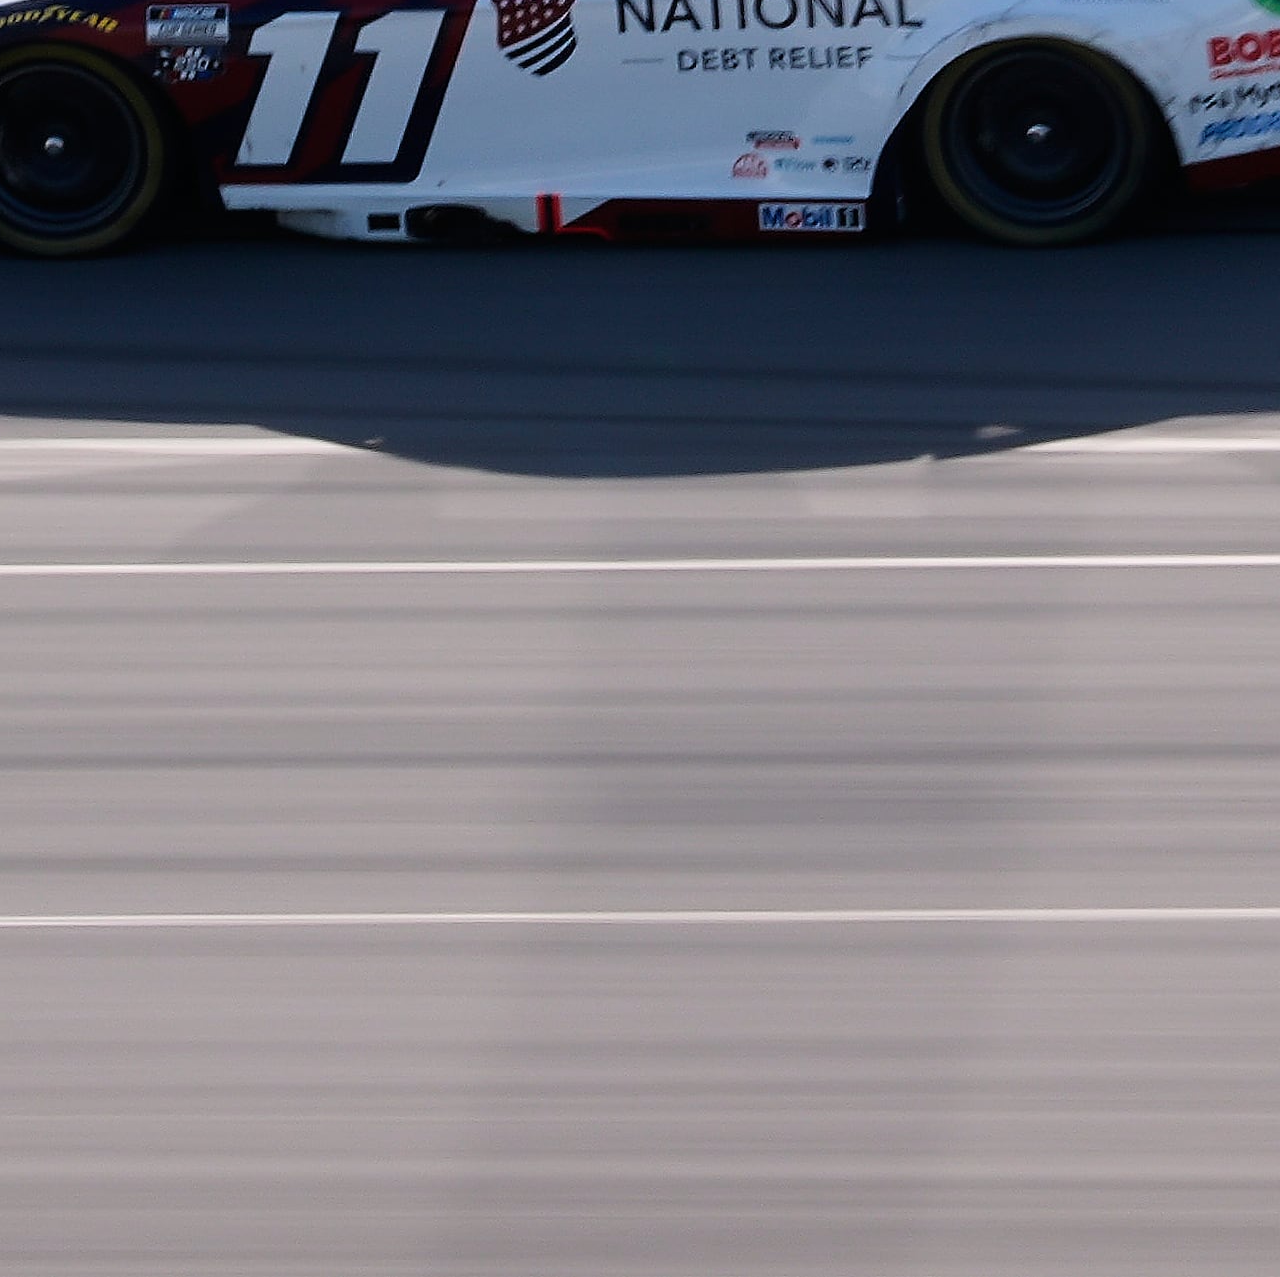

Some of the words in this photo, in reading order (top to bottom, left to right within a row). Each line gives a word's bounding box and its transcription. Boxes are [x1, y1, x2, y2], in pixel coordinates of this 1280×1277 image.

[677, 48, 758, 72] DEBT
[770, 45, 874, 70] RELIEF
[235, 10, 446, 166] 11
[762, 207, 835, 228] Mobil
